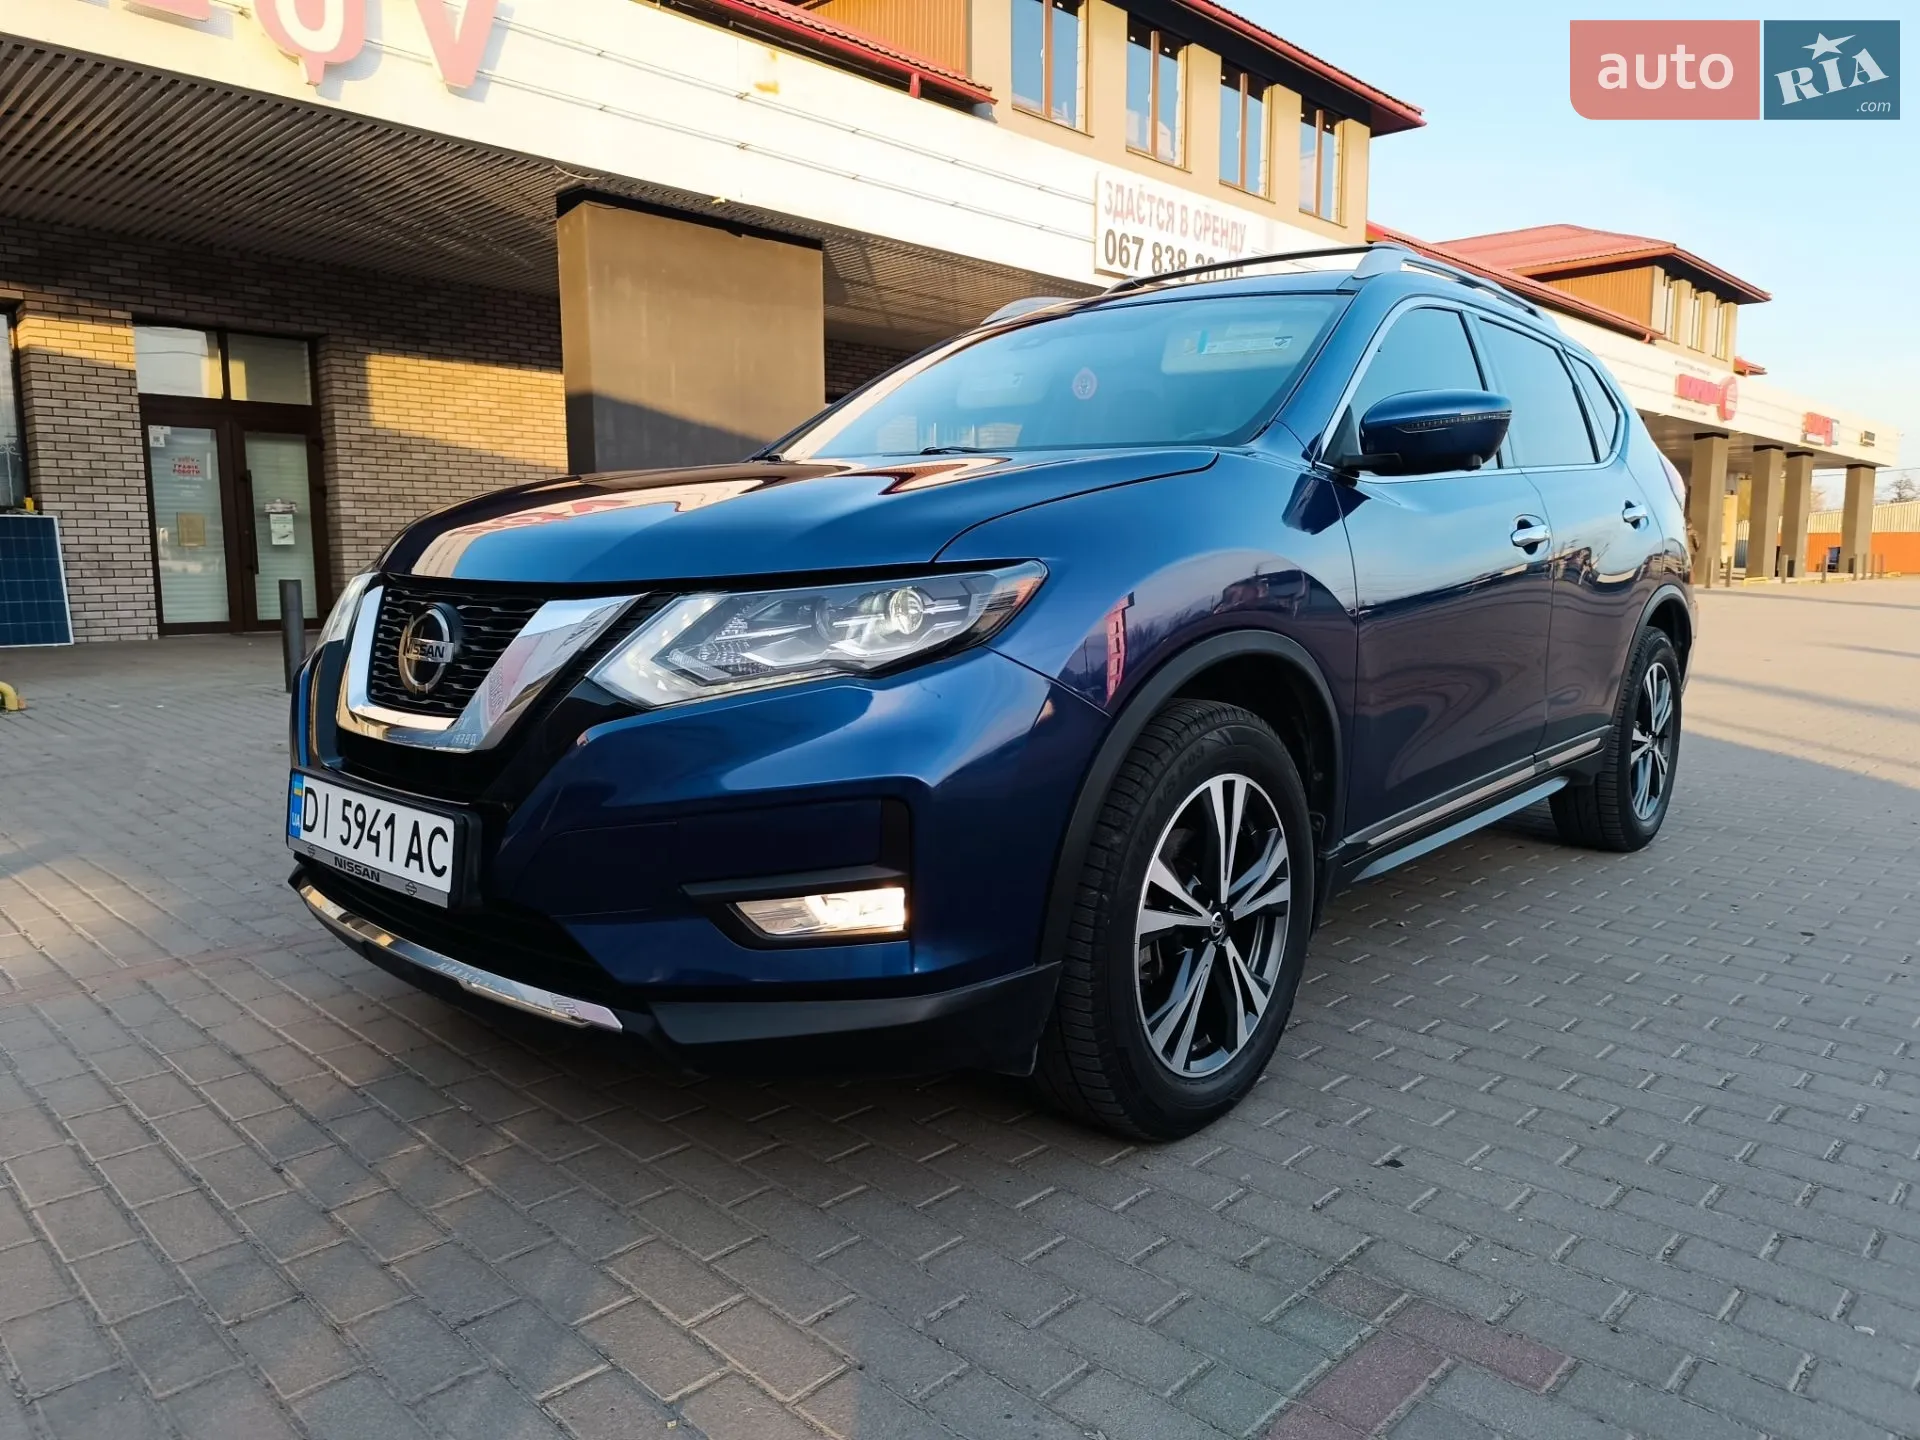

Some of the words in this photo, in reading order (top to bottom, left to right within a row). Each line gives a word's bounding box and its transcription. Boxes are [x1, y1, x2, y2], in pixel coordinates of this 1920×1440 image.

[1105, 180, 1175, 234] ЗДАЄТСЯ
[1180, 204, 1189, 238] В
[1193, 208, 1247, 258] ОРЕНДУ
[1104, 228, 1145, 272] 067
[1151, 241, 1188, 282] 838
[303, 786, 329, 839] DI
[340, 798, 396, 862] 5941
[404, 820, 448, 877] AC
[334, 856, 380, 882] NISSAN
